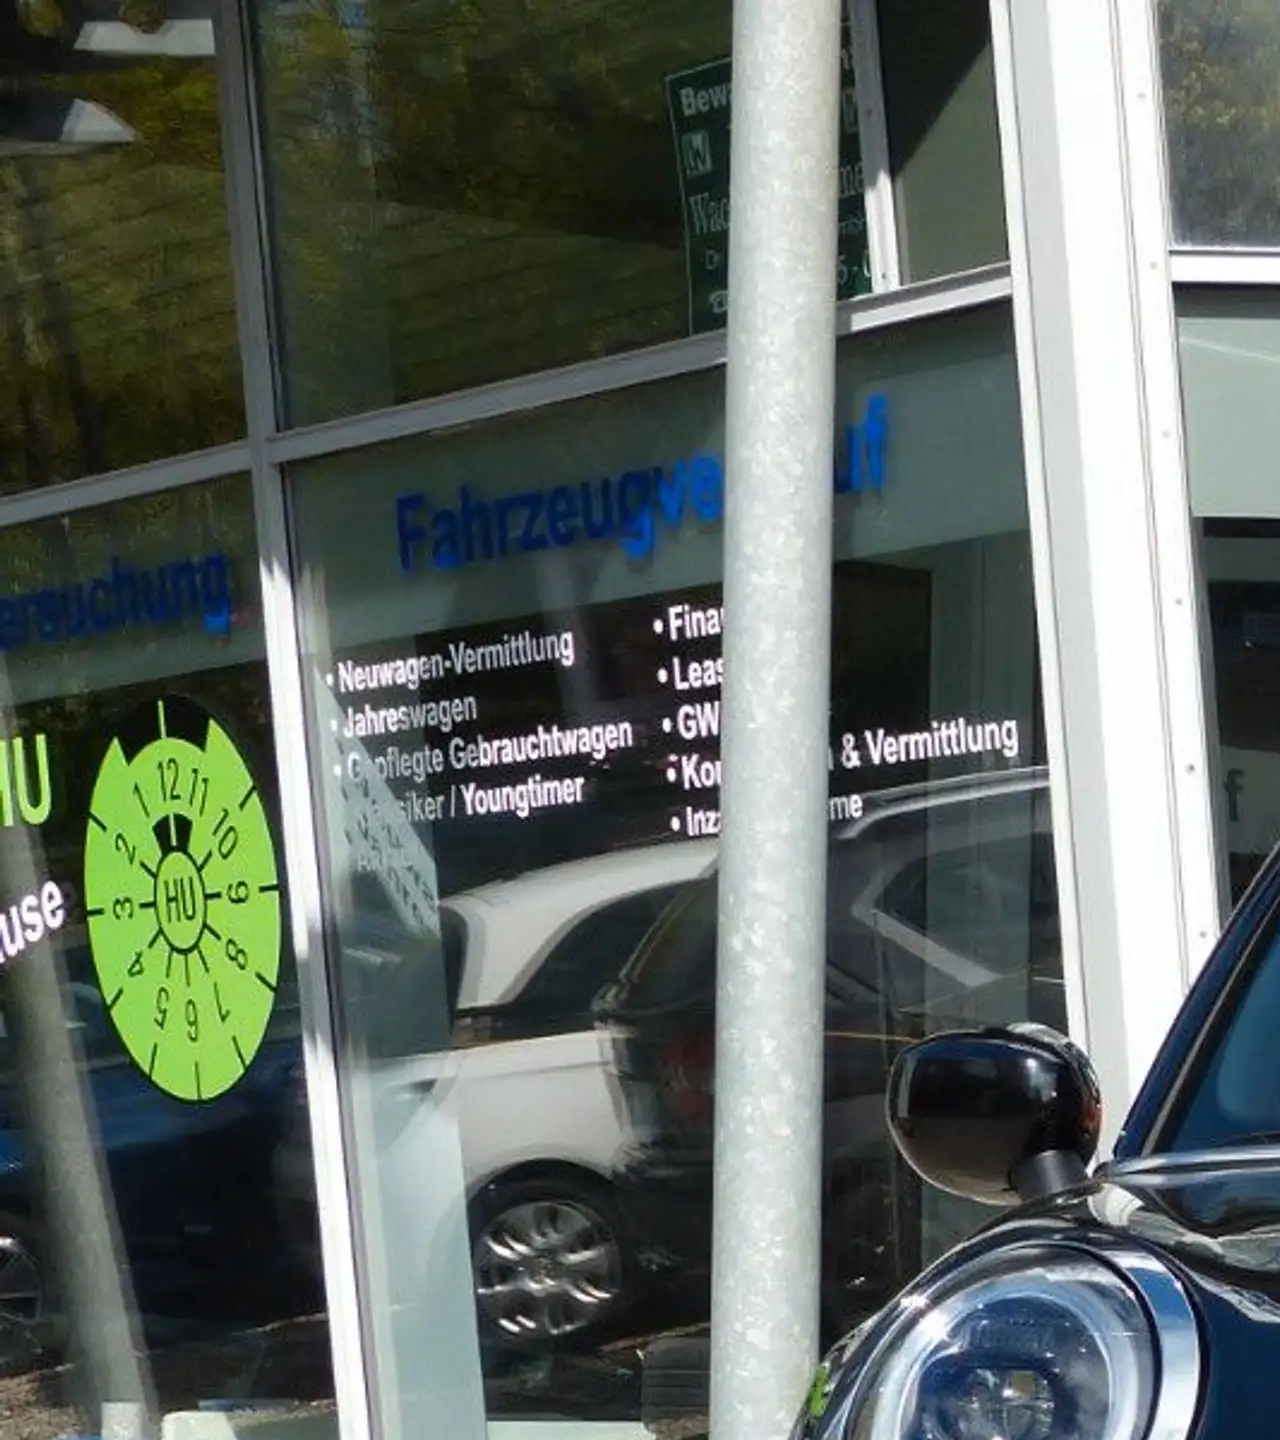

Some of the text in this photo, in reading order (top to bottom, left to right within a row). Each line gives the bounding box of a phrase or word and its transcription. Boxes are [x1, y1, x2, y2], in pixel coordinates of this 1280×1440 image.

[679, 83, 732, 117] Bew
[0, 552, 232, 648] ersuchung
[337, 630, 575, 693] Neuwagen-Vermittlung
[342, 695, 477, 739] Jahreswagen
[449, 719, 633, 770] Gebrauchtwagen
[841, 732, 862, 770] &
[864, 717, 1019, 766] Vermittlung
[156, 758, 182, 802] 12
[460, 774, 585, 818] Youngtimer
[0, 879, 65, 963] use
[162, 876, 197, 924] HU
